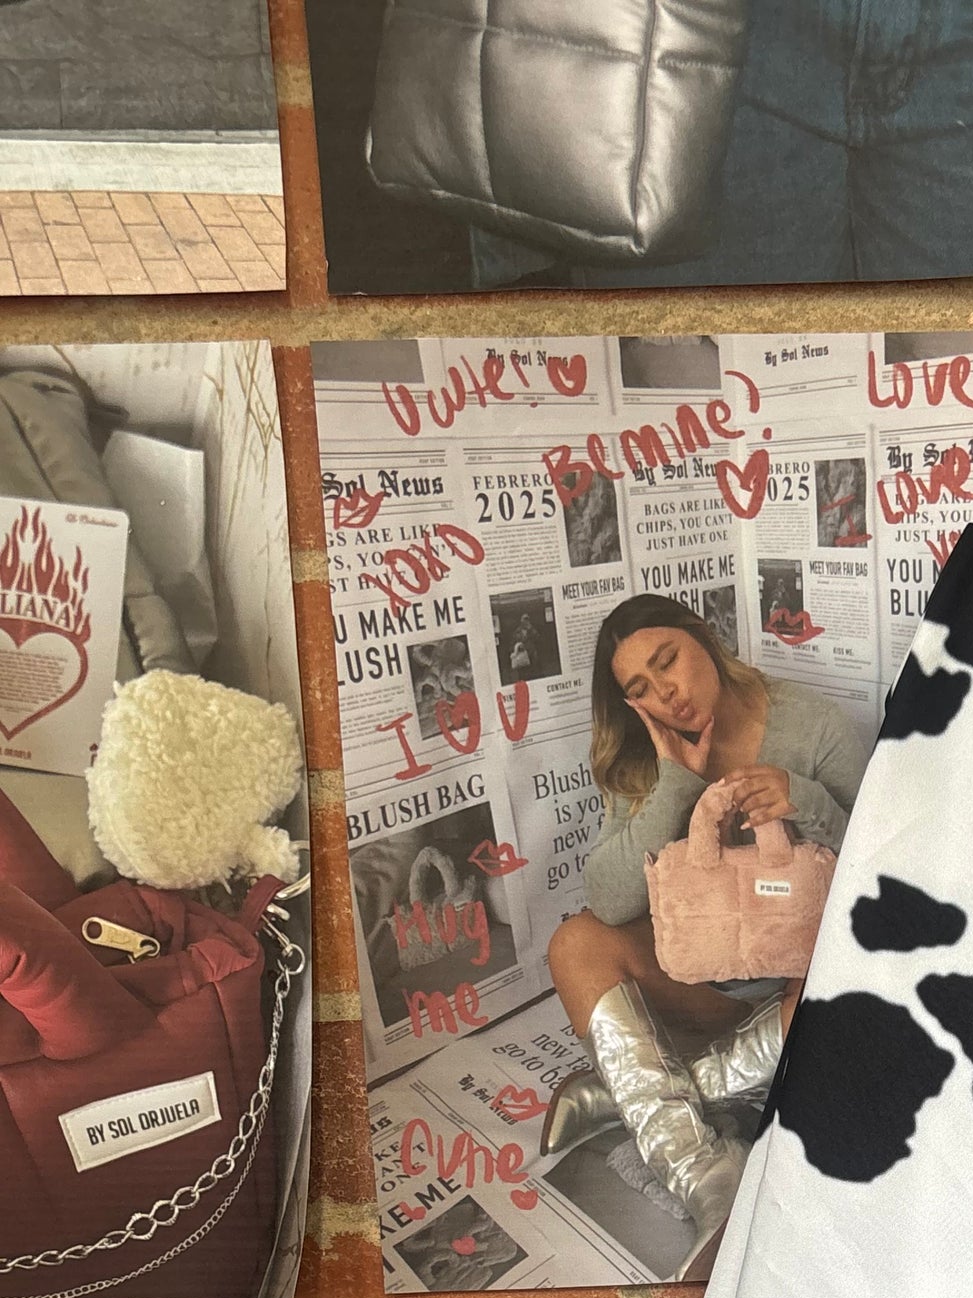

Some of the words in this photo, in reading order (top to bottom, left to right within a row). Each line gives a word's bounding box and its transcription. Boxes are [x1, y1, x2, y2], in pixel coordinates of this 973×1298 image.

[781, 348, 798, 362] Sol
[801, 344, 829, 359] News
[378, 470, 444, 498] News
[475, 488, 556, 523] 2025
[644, 502, 676, 517] BAGS
[680, 500, 700, 513] ARE
[704, 498, 727, 510] LIKE
[939, 510, 973, 524] YOU
[355, 528, 394, 545] ARE
[636, 520, 678, 535] CHIPS,
[680, 516, 702, 531] YOU
[705, 513, 734, 528] CAN'T
[895, 530, 931, 543] JUST
[646, 535, 675, 551] JUST
[679, 532, 707, 547] HAVE
[709, 530, 729, 543] ONE
[641, 563, 672, 591] YOU
[678, 557, 715, 585] MAKE
[719, 554, 736, 578] ME
[809, 560, 826, 575] MEET
[825, 561, 842, 576] YOUR
[855, 562, 868, 577] BAG
[887, 558, 923, 585] YOU
[562, 583, 580, 600] MEET
[581, 581, 599, 598] YOUR
[612, 576, 626, 593] BAG
[358, 602, 427, 641] MAKE
[433, 595, 466, 627] ME
[532, 762, 593, 800] Blush
[346, 791, 432, 842] BLUSH
[436, 774, 486, 811] BAG
[555, 799, 572, 825] is
[553, 825, 591, 855] new
[547, 862, 570, 890] go
[402, 981, 489, 1038] me
[492, 1042, 526, 1058] go
[521, 1055, 545, 1072] to
[531, 1033, 572, 1060] new
[86, 1124, 105, 1146] BY
[110, 1115, 138, 1140] SOL
[138, 1098, 200, 1132] ORJUELA
[414, 1176, 462, 1210] ME
